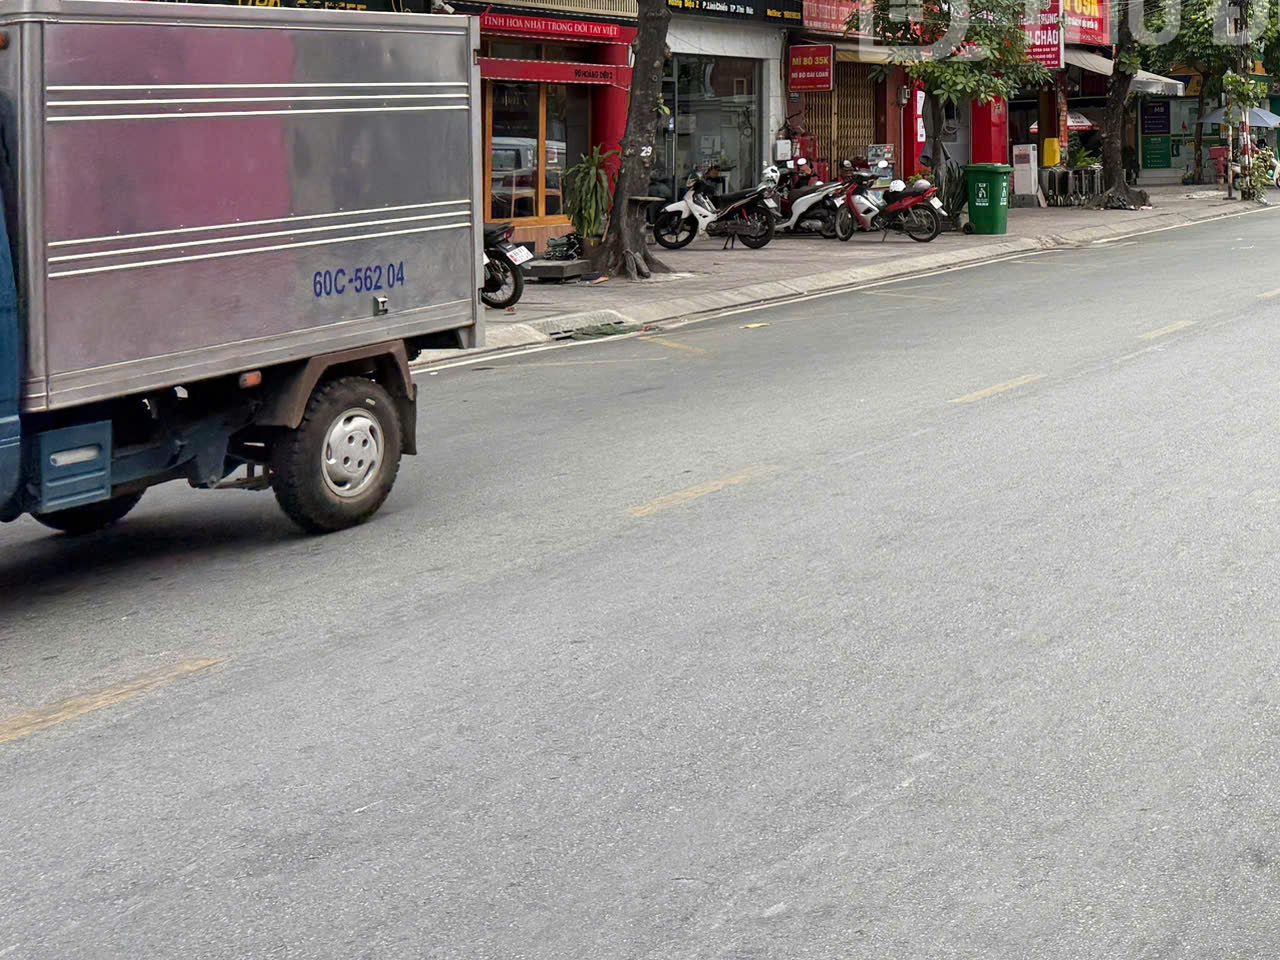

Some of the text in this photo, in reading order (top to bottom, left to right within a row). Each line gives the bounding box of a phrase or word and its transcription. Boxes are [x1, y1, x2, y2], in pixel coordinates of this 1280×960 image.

[485, 16, 505, 26] TINH
[506, 18, 523, 28] HOA
[547, 21, 573, 32] TRONG
[589, 25, 601, 34] TAY
[815, 56, 829, 65] 35K
